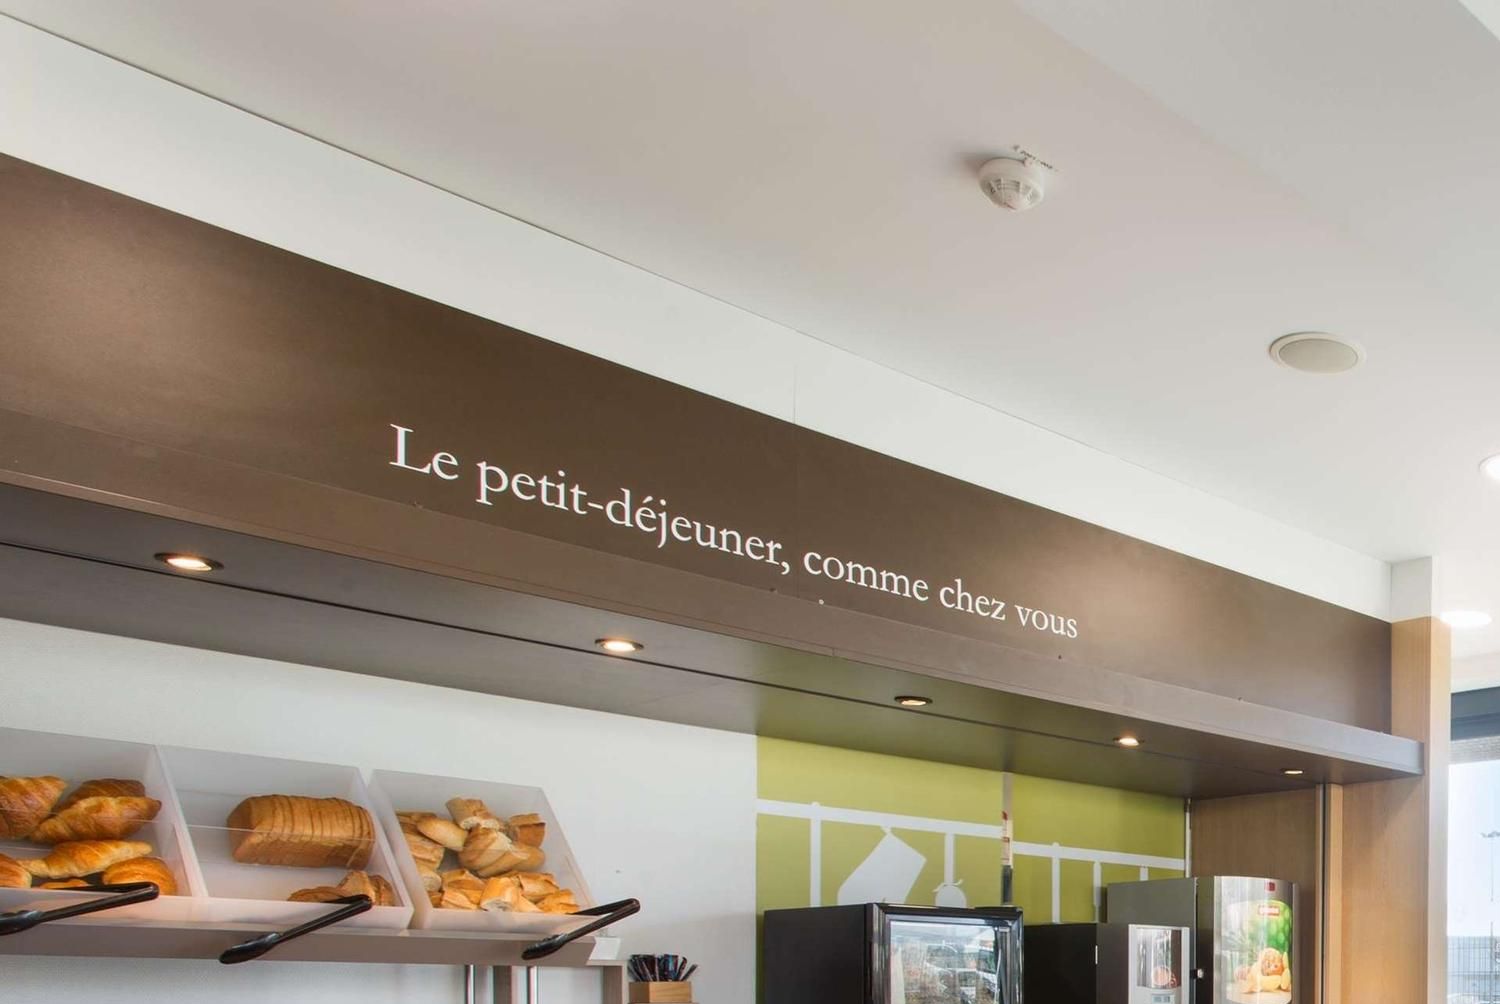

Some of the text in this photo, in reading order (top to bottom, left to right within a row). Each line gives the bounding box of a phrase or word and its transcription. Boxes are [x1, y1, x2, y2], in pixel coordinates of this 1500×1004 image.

[389, 424, 1079, 639] Le petit-déjeuner, comme chez vous
